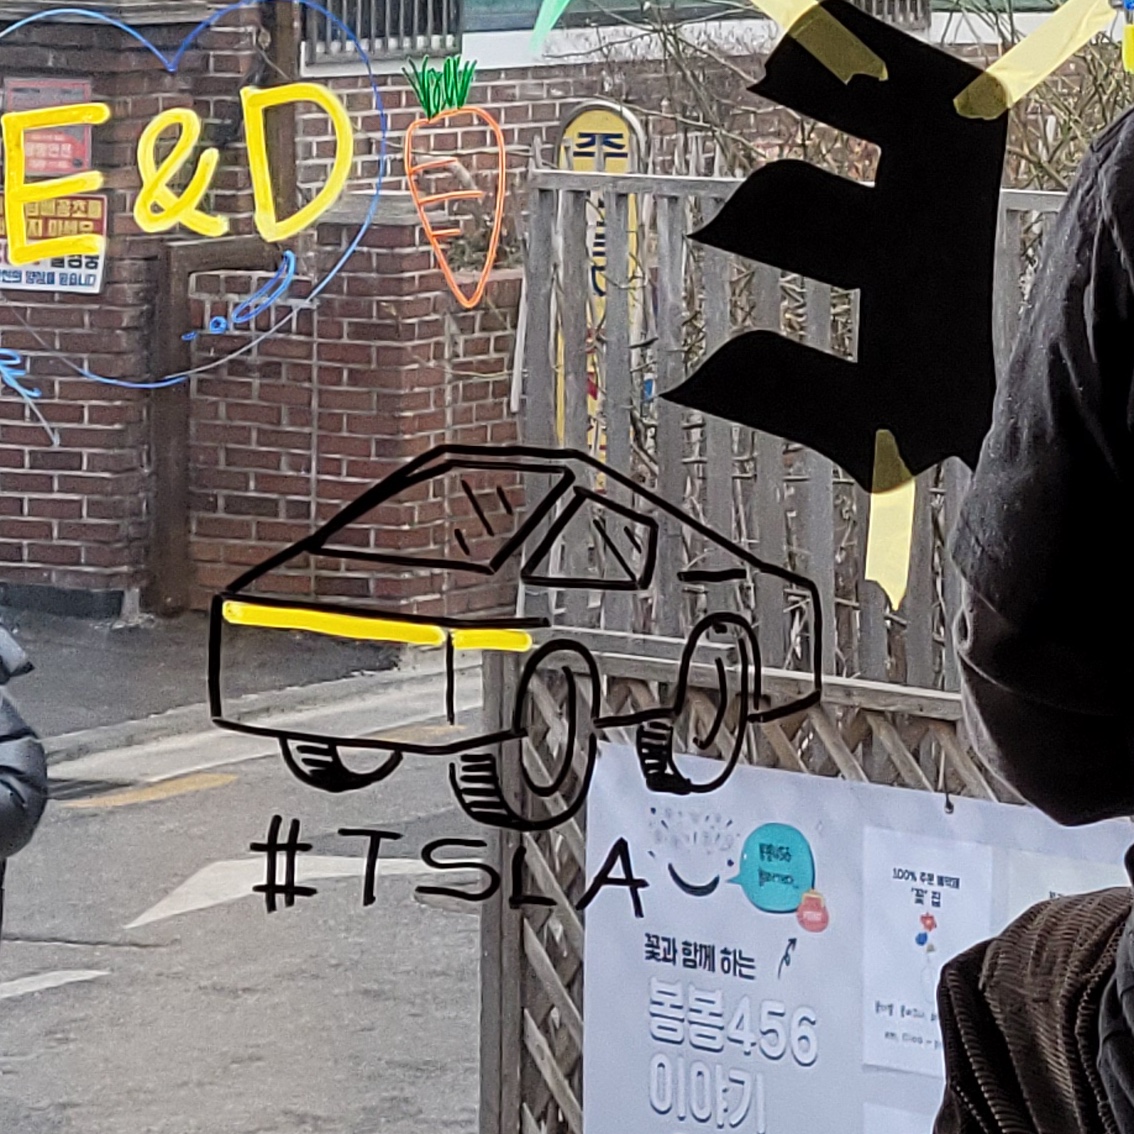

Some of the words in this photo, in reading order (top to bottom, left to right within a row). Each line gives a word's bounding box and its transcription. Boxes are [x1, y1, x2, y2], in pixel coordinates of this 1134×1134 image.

[644, 932, 678, 967] 꽃과
[681, 940, 716, 973] 함께
[720, 946, 757, 981] 하는
